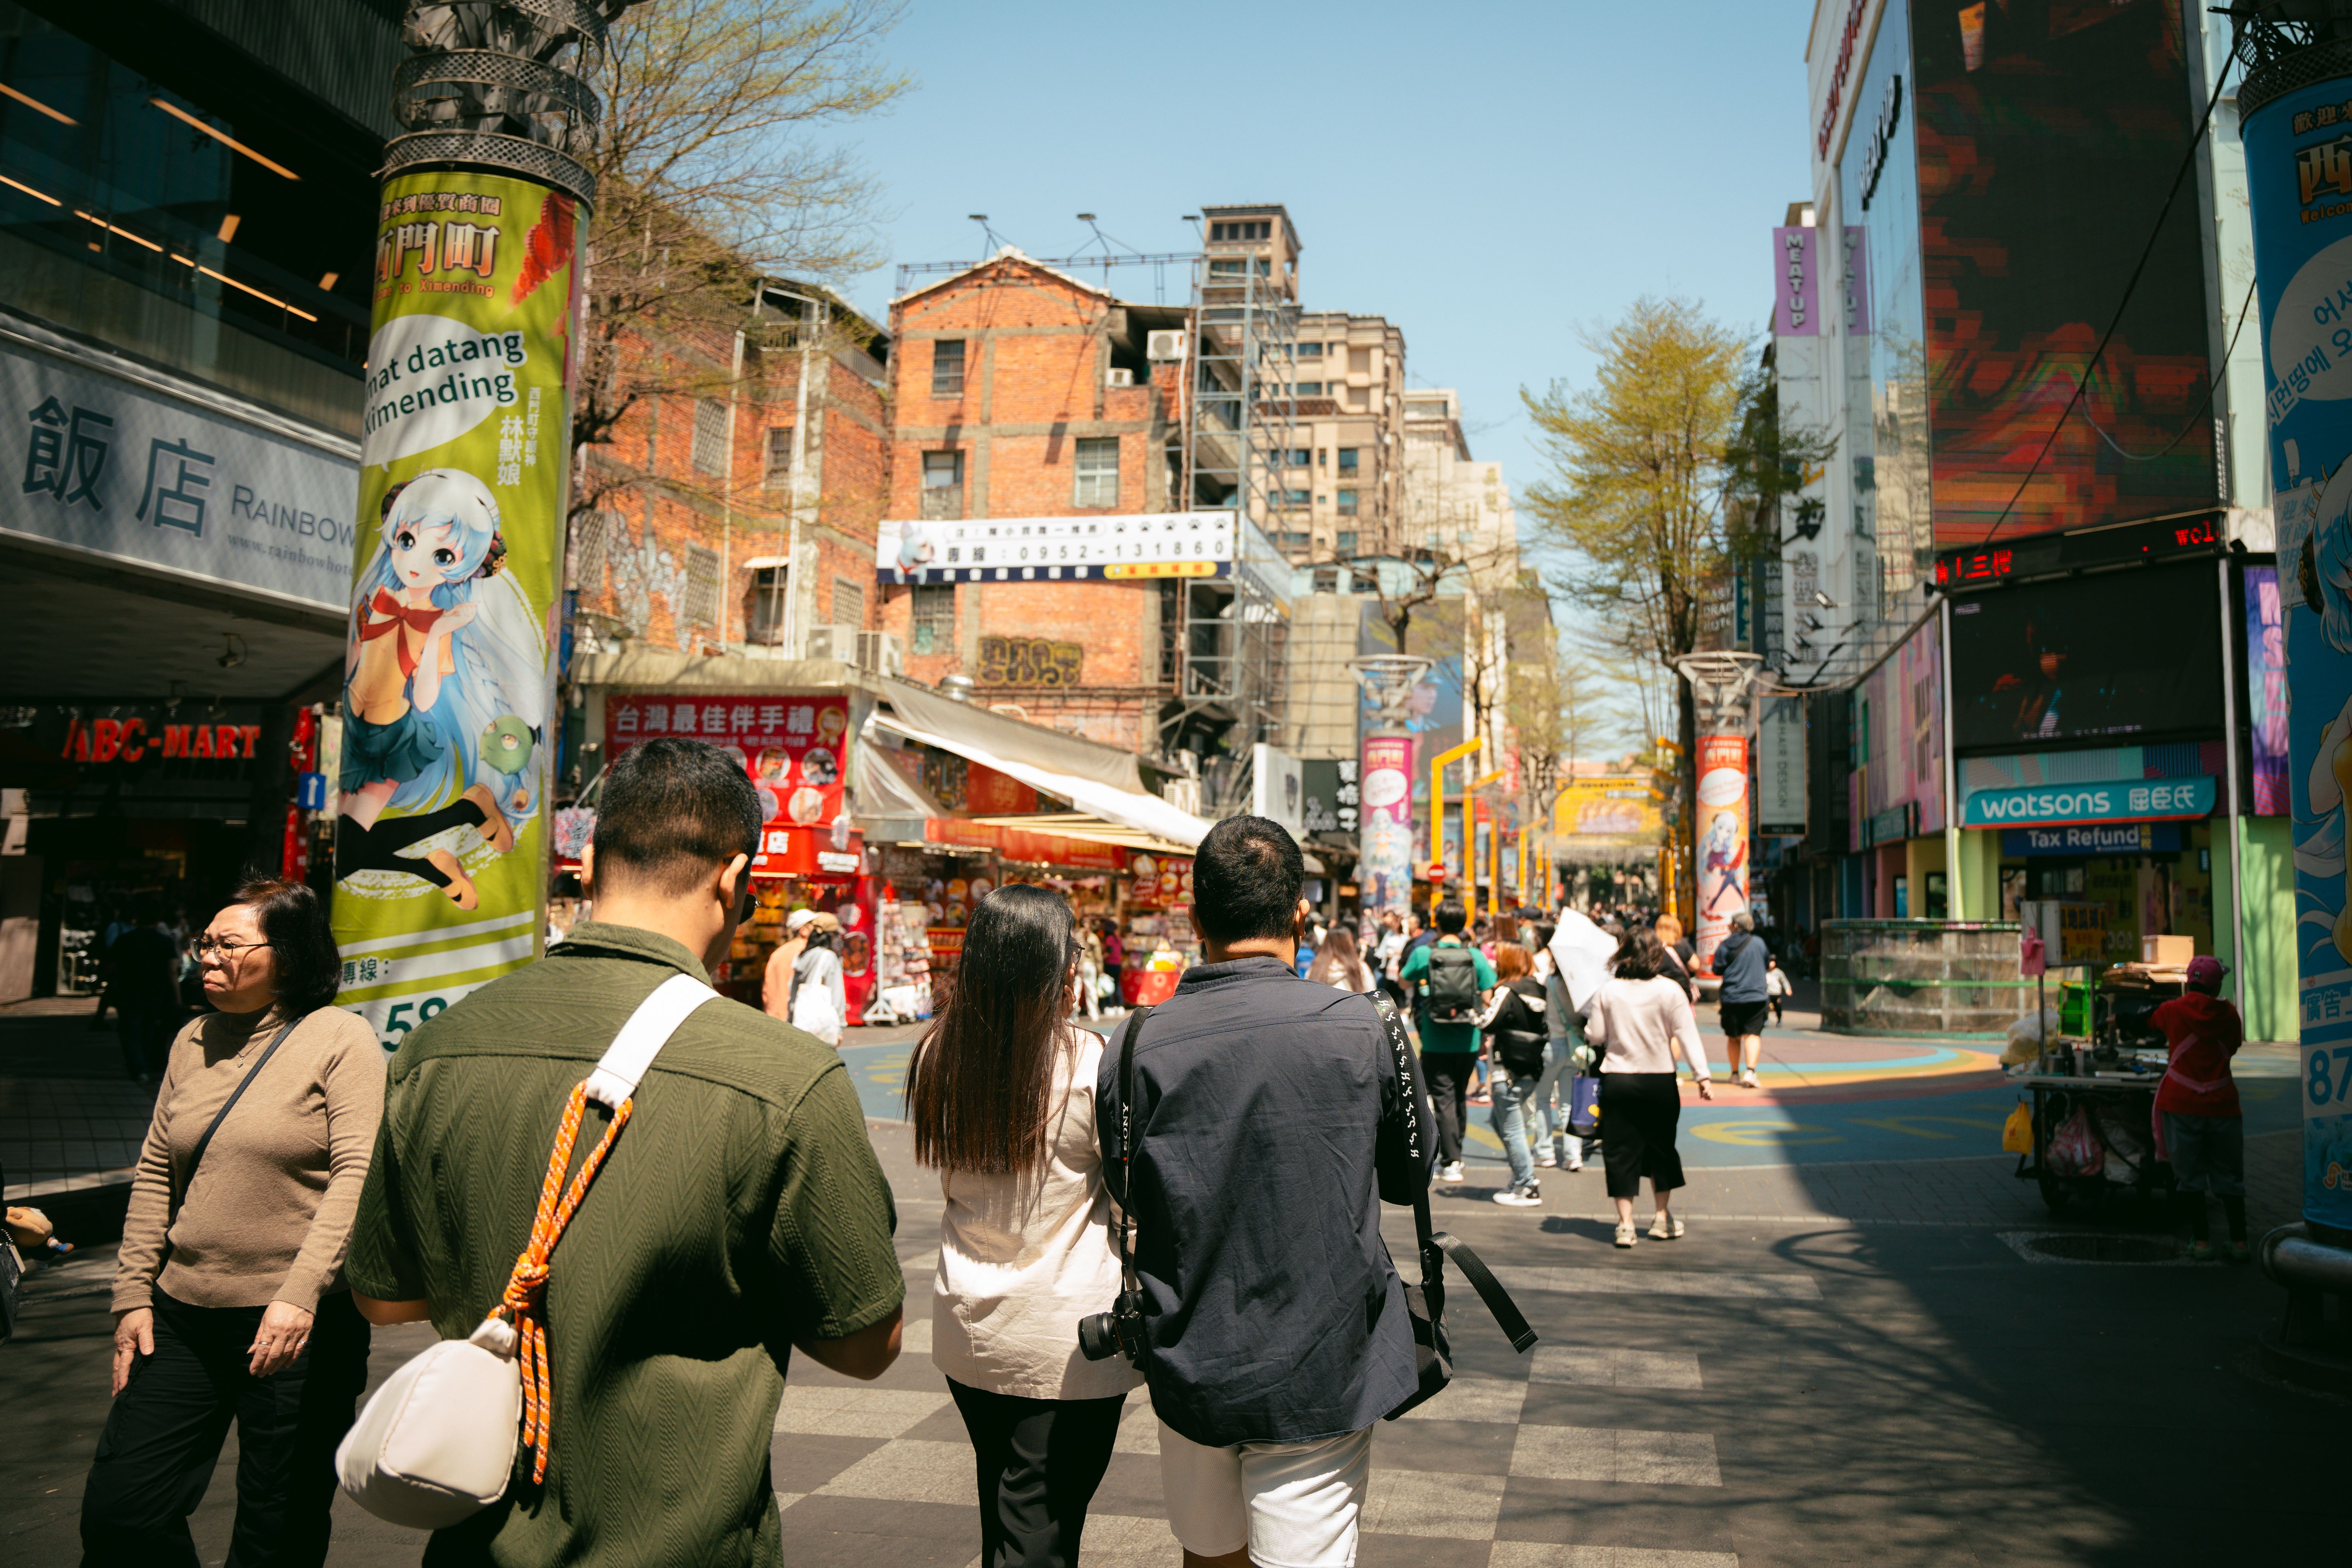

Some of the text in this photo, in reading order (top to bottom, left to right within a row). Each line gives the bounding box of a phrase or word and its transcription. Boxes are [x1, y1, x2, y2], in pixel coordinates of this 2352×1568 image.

[398, 282, 412, 294] to
[419, 278, 495, 298] Ximending
[407, 334, 524, 374] datang
[364, 372, 515, 436] Ximending
[22, 394, 216, 538] 飯店
[497, 415, 524, 487] 林默娘
[232, 484, 357, 548] RAINBOW
[62, 717, 261, 762] ABC-MART
[616, 704, 814, 734] 台灣最佳伴手禮
[1981, 785, 2195, 819] watsons 屈臣氏
[2027, 825, 2139, 848] Tax Refund
